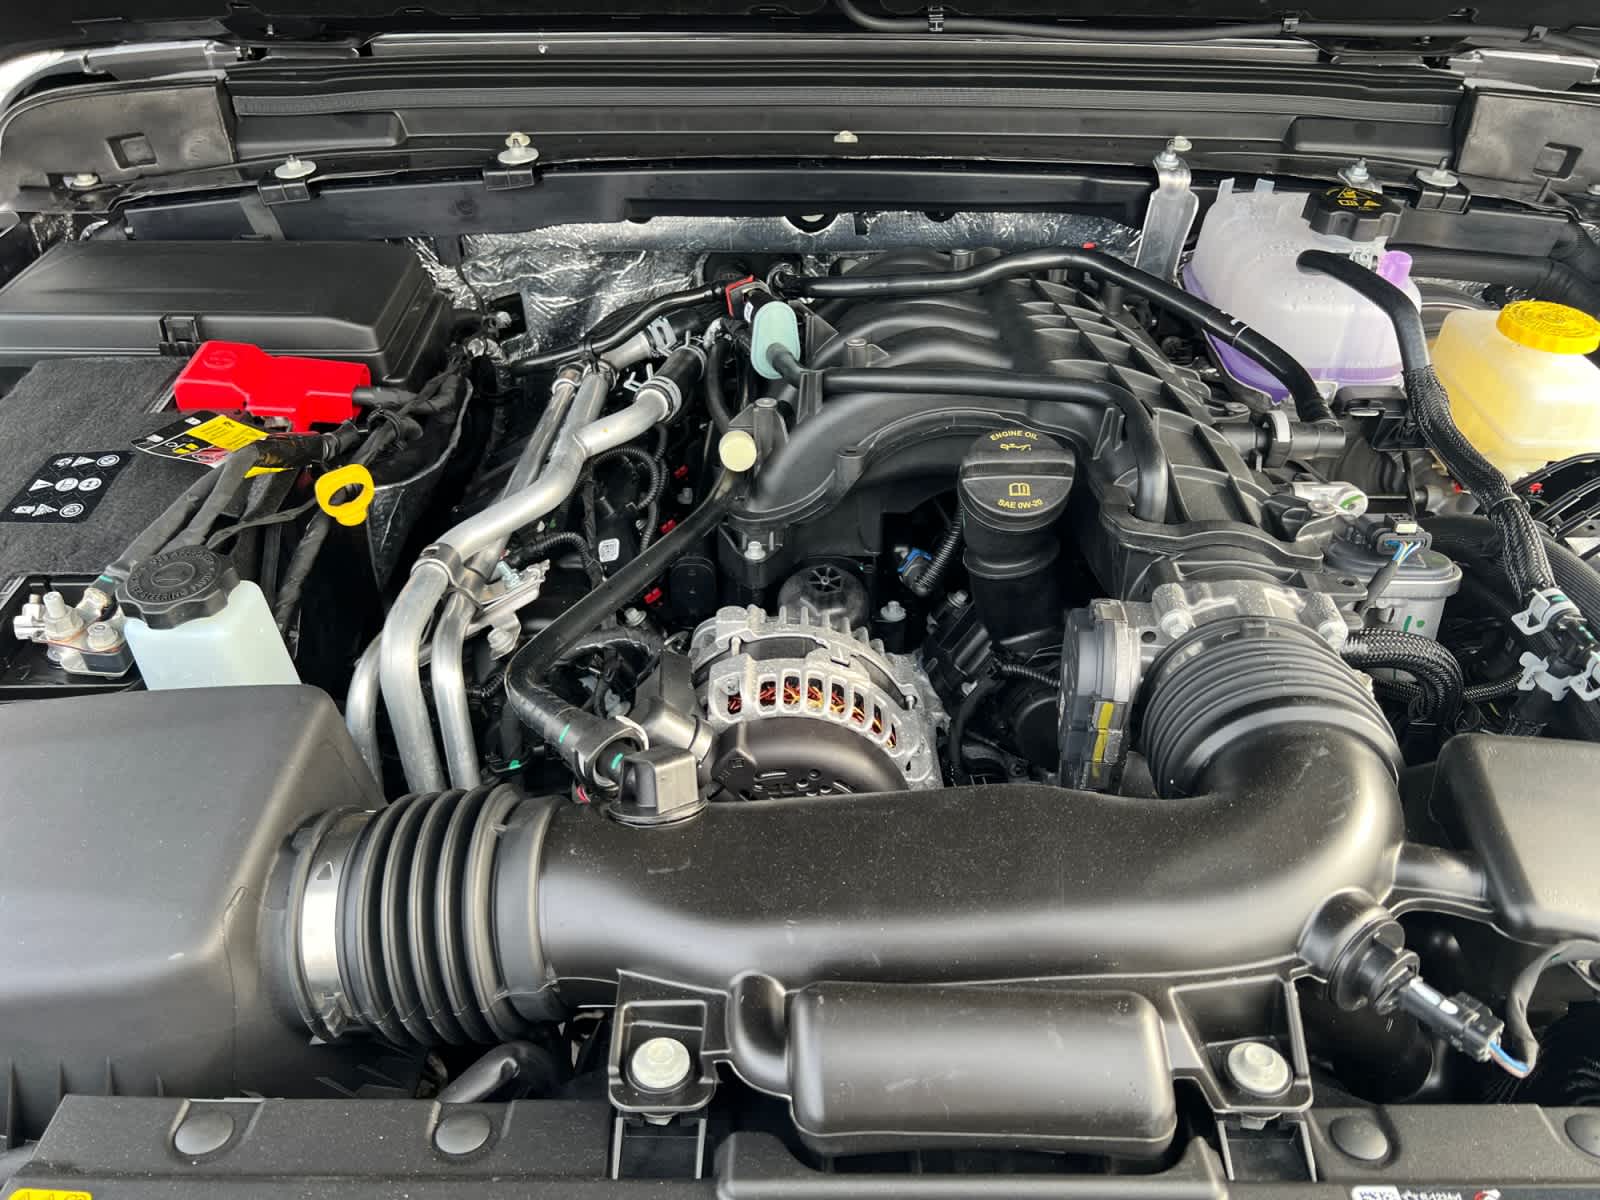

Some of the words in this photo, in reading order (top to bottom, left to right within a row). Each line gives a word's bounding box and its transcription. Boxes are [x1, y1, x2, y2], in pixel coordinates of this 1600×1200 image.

[990, 430, 1023, 441] ENGINE
[1024, 431, 1039, 440] OIL
[998, 499, 1016, 509] SAE
